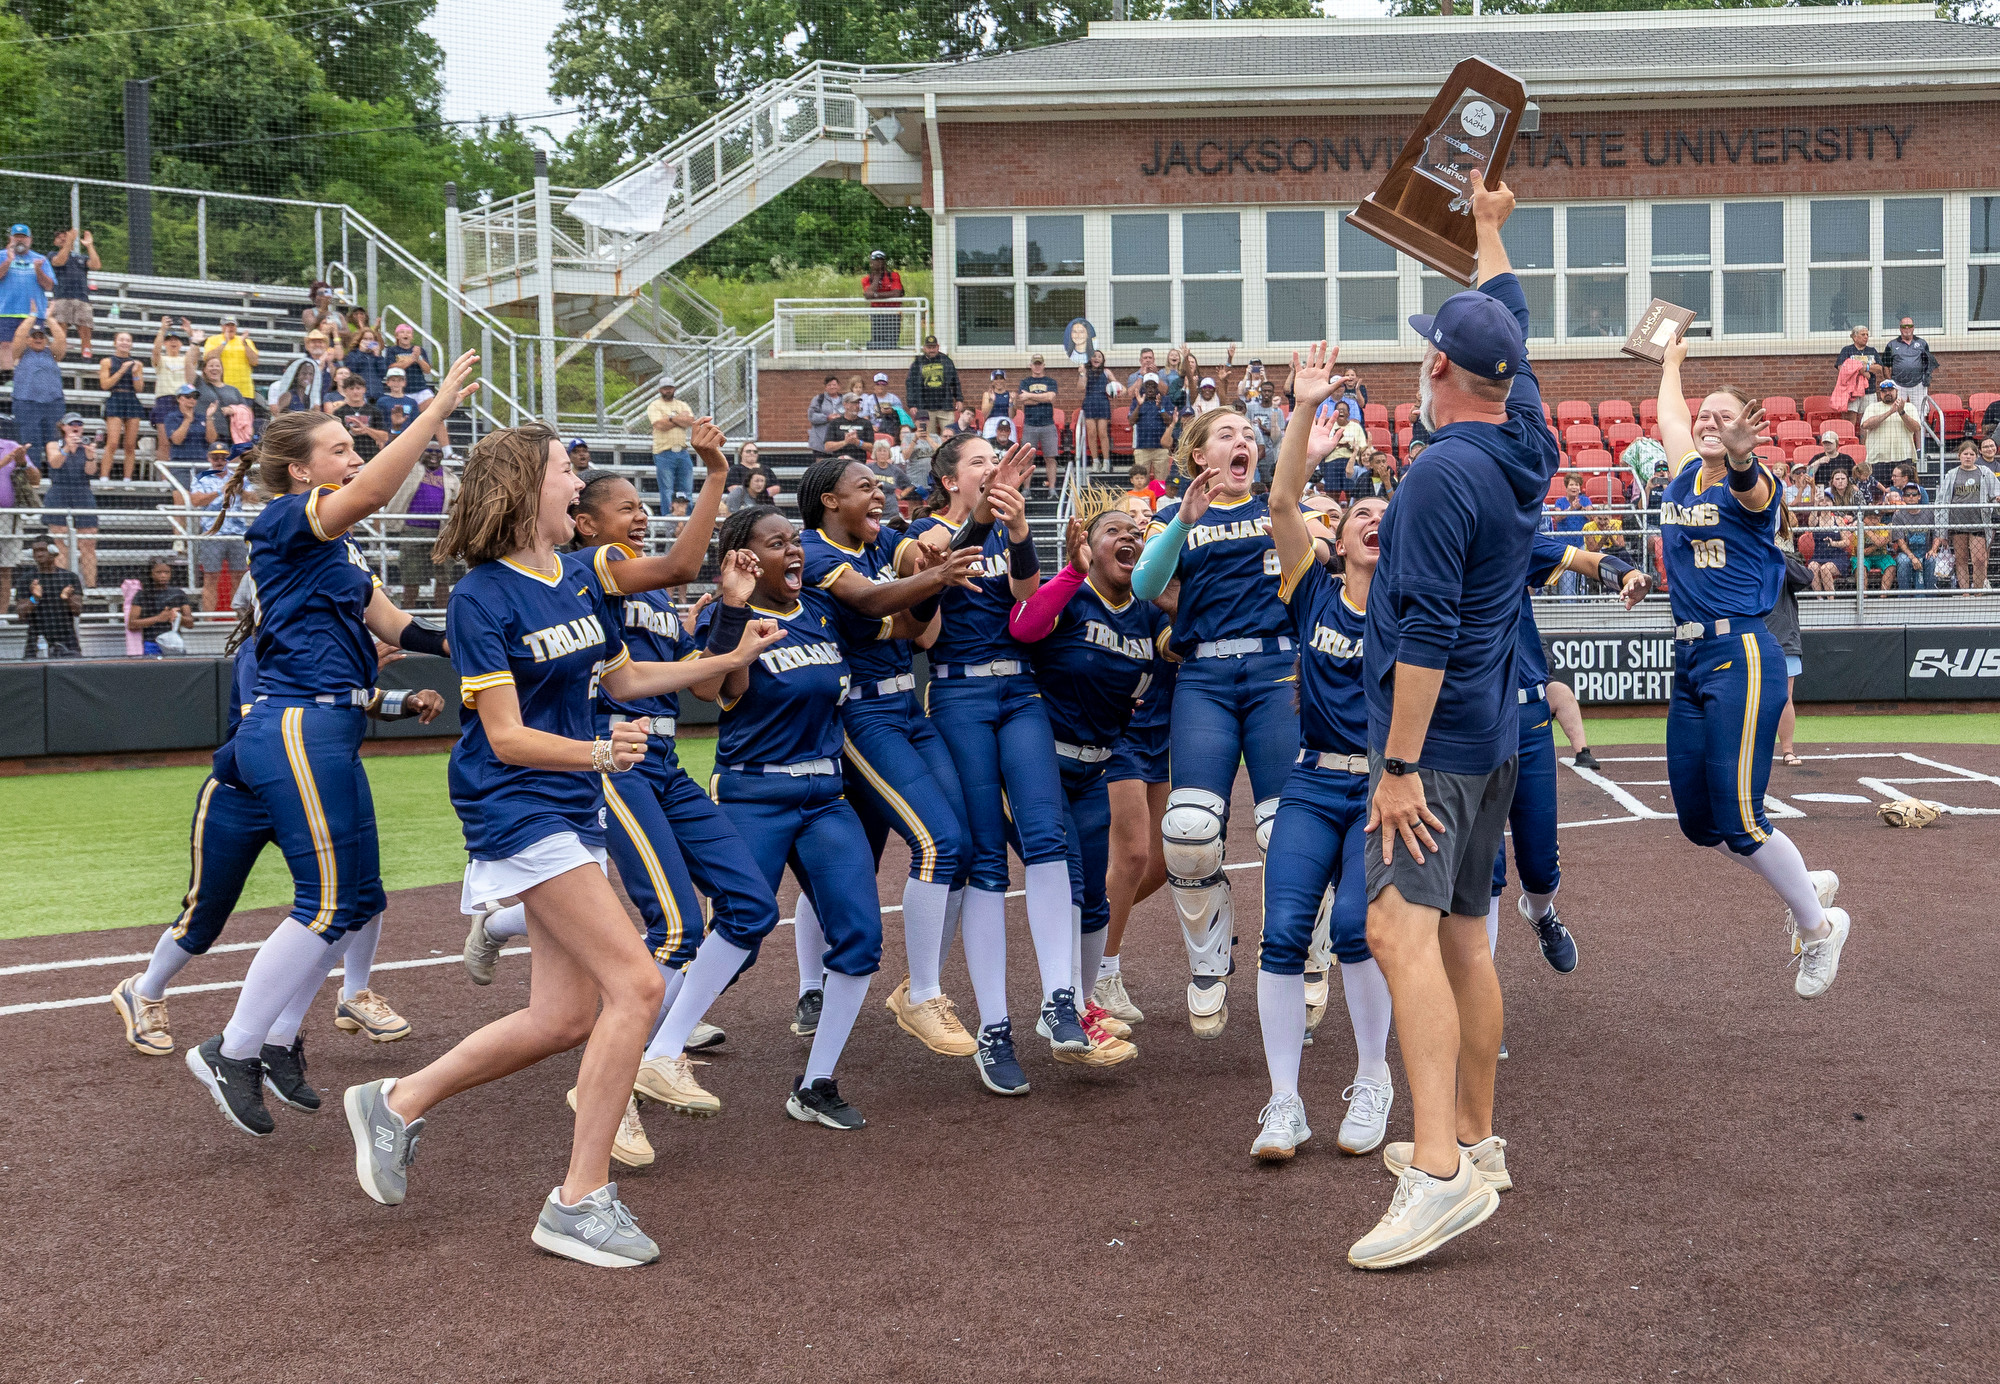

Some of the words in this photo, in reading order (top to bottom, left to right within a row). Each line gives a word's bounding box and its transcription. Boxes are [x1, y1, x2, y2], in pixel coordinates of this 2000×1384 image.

[1643, 123, 1916, 167] UNIVERSITY
[1640, 305, 1665, 335] AHSAA
[1690, 538, 1727, 569] 00
[1552, 640, 1622, 669] SCOTT
[1574, 671, 1675, 701] PROPERT
[375, 1126, 394, 1152] N
[575, 1216, 605, 1240] N
